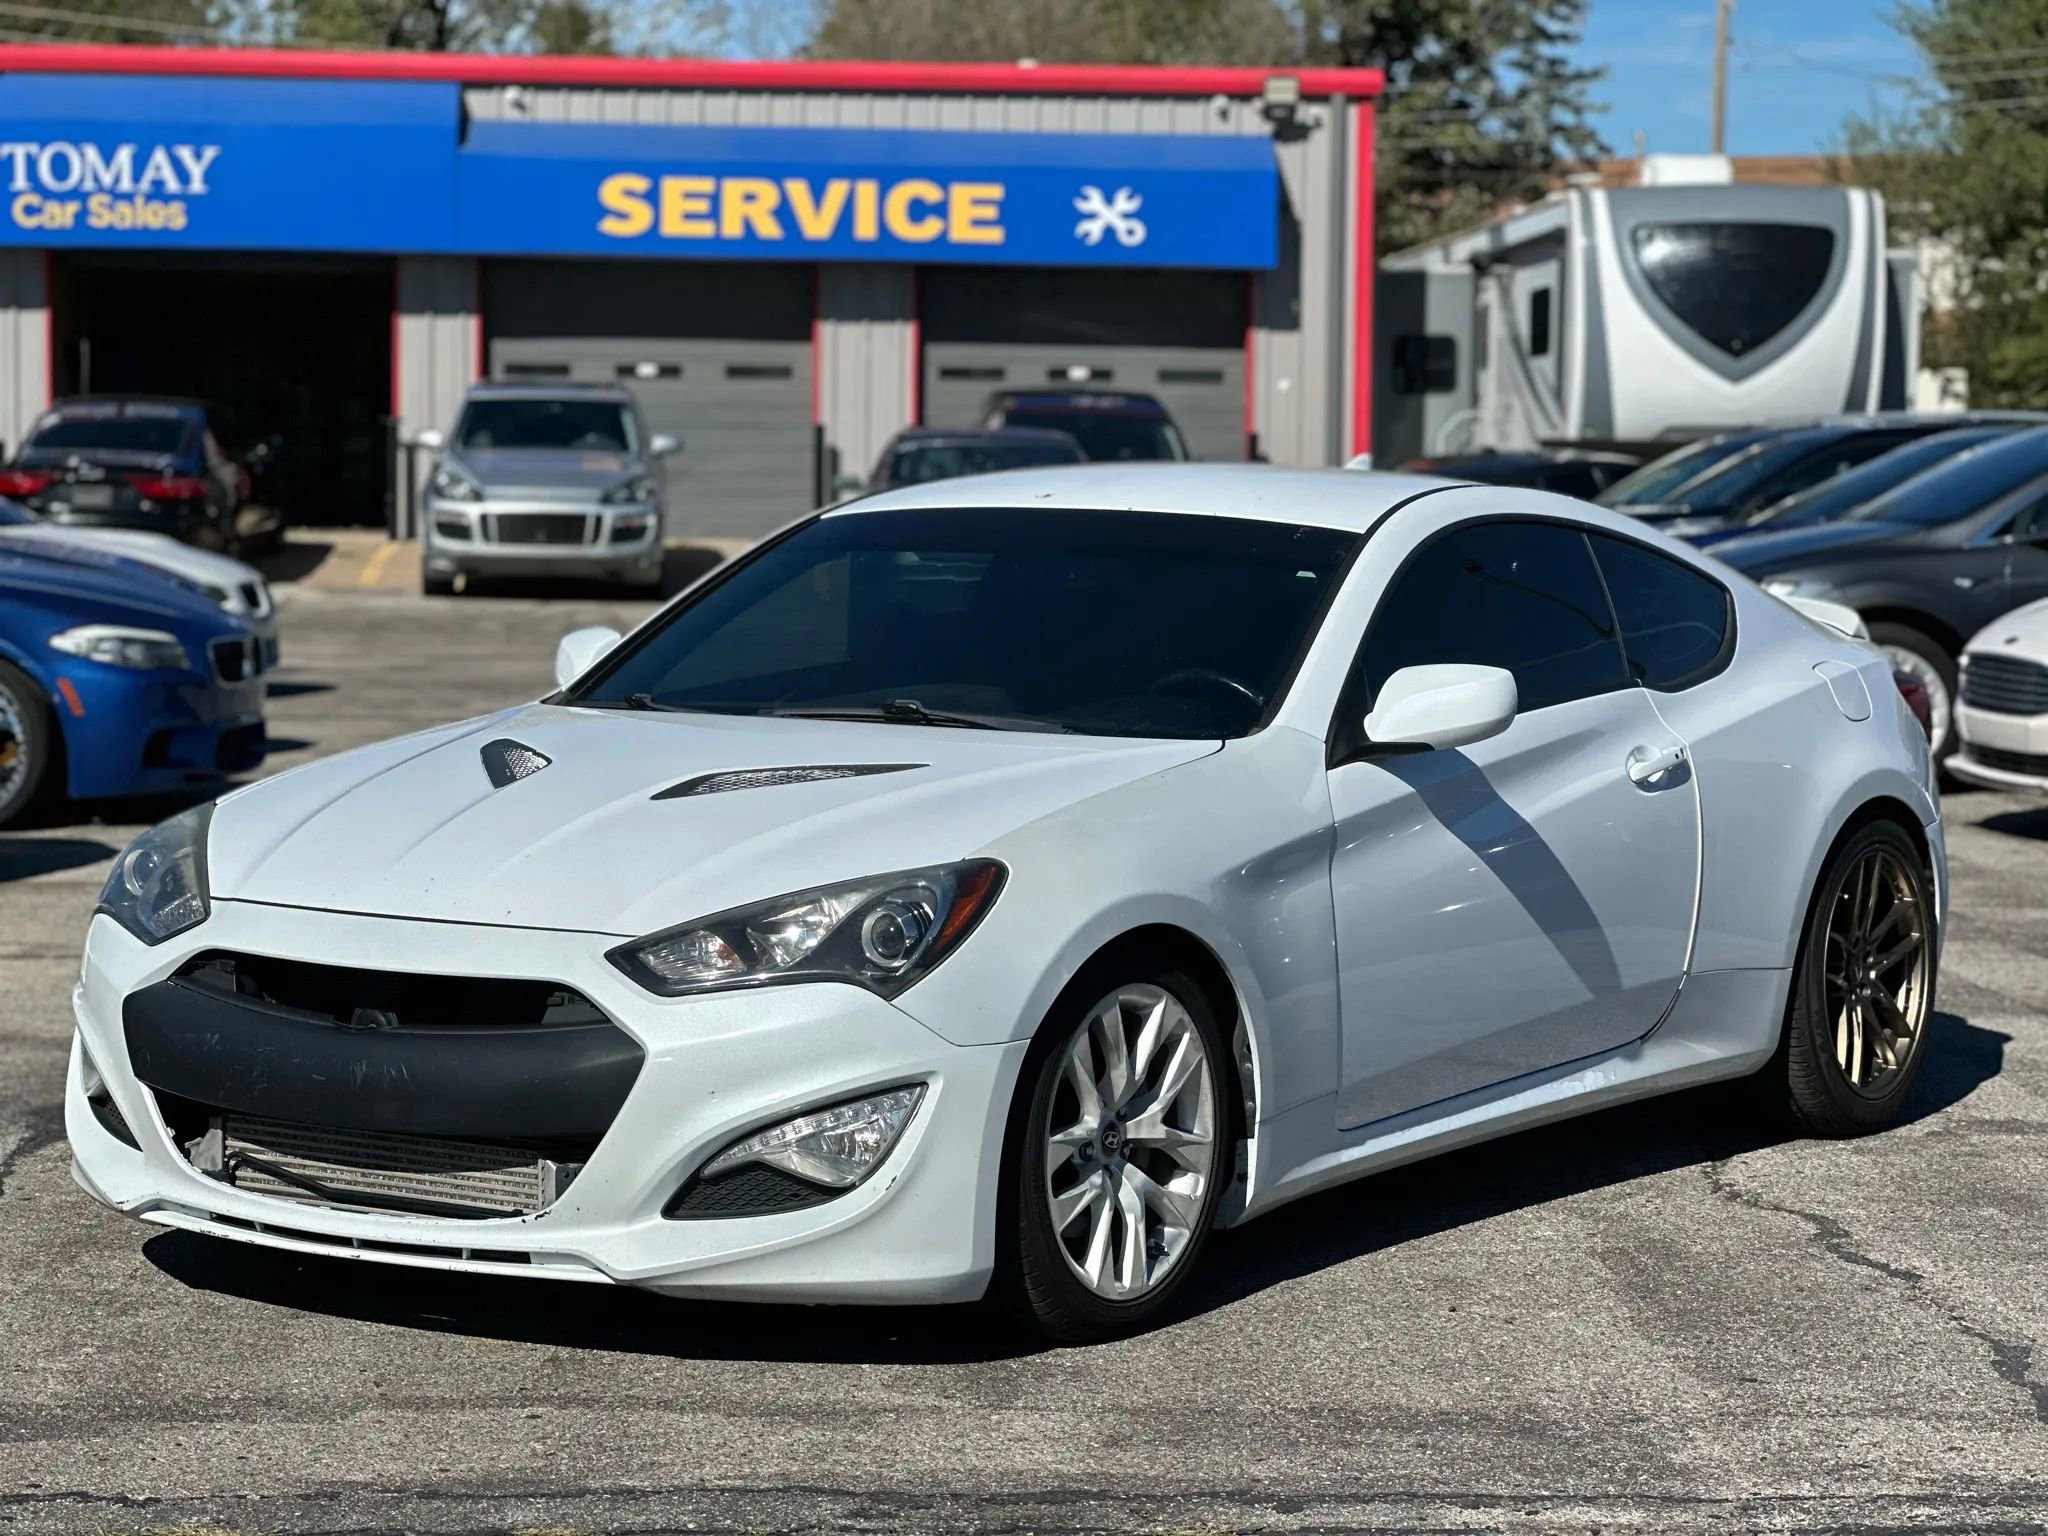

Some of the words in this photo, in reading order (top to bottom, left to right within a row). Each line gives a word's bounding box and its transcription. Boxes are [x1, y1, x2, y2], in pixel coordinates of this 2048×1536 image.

[0, 142, 220, 194] TOMAY
[11, 193, 80, 229] Car
[87, 193, 188, 230] Sales
[598, 173, 1005, 244] SERVICE
